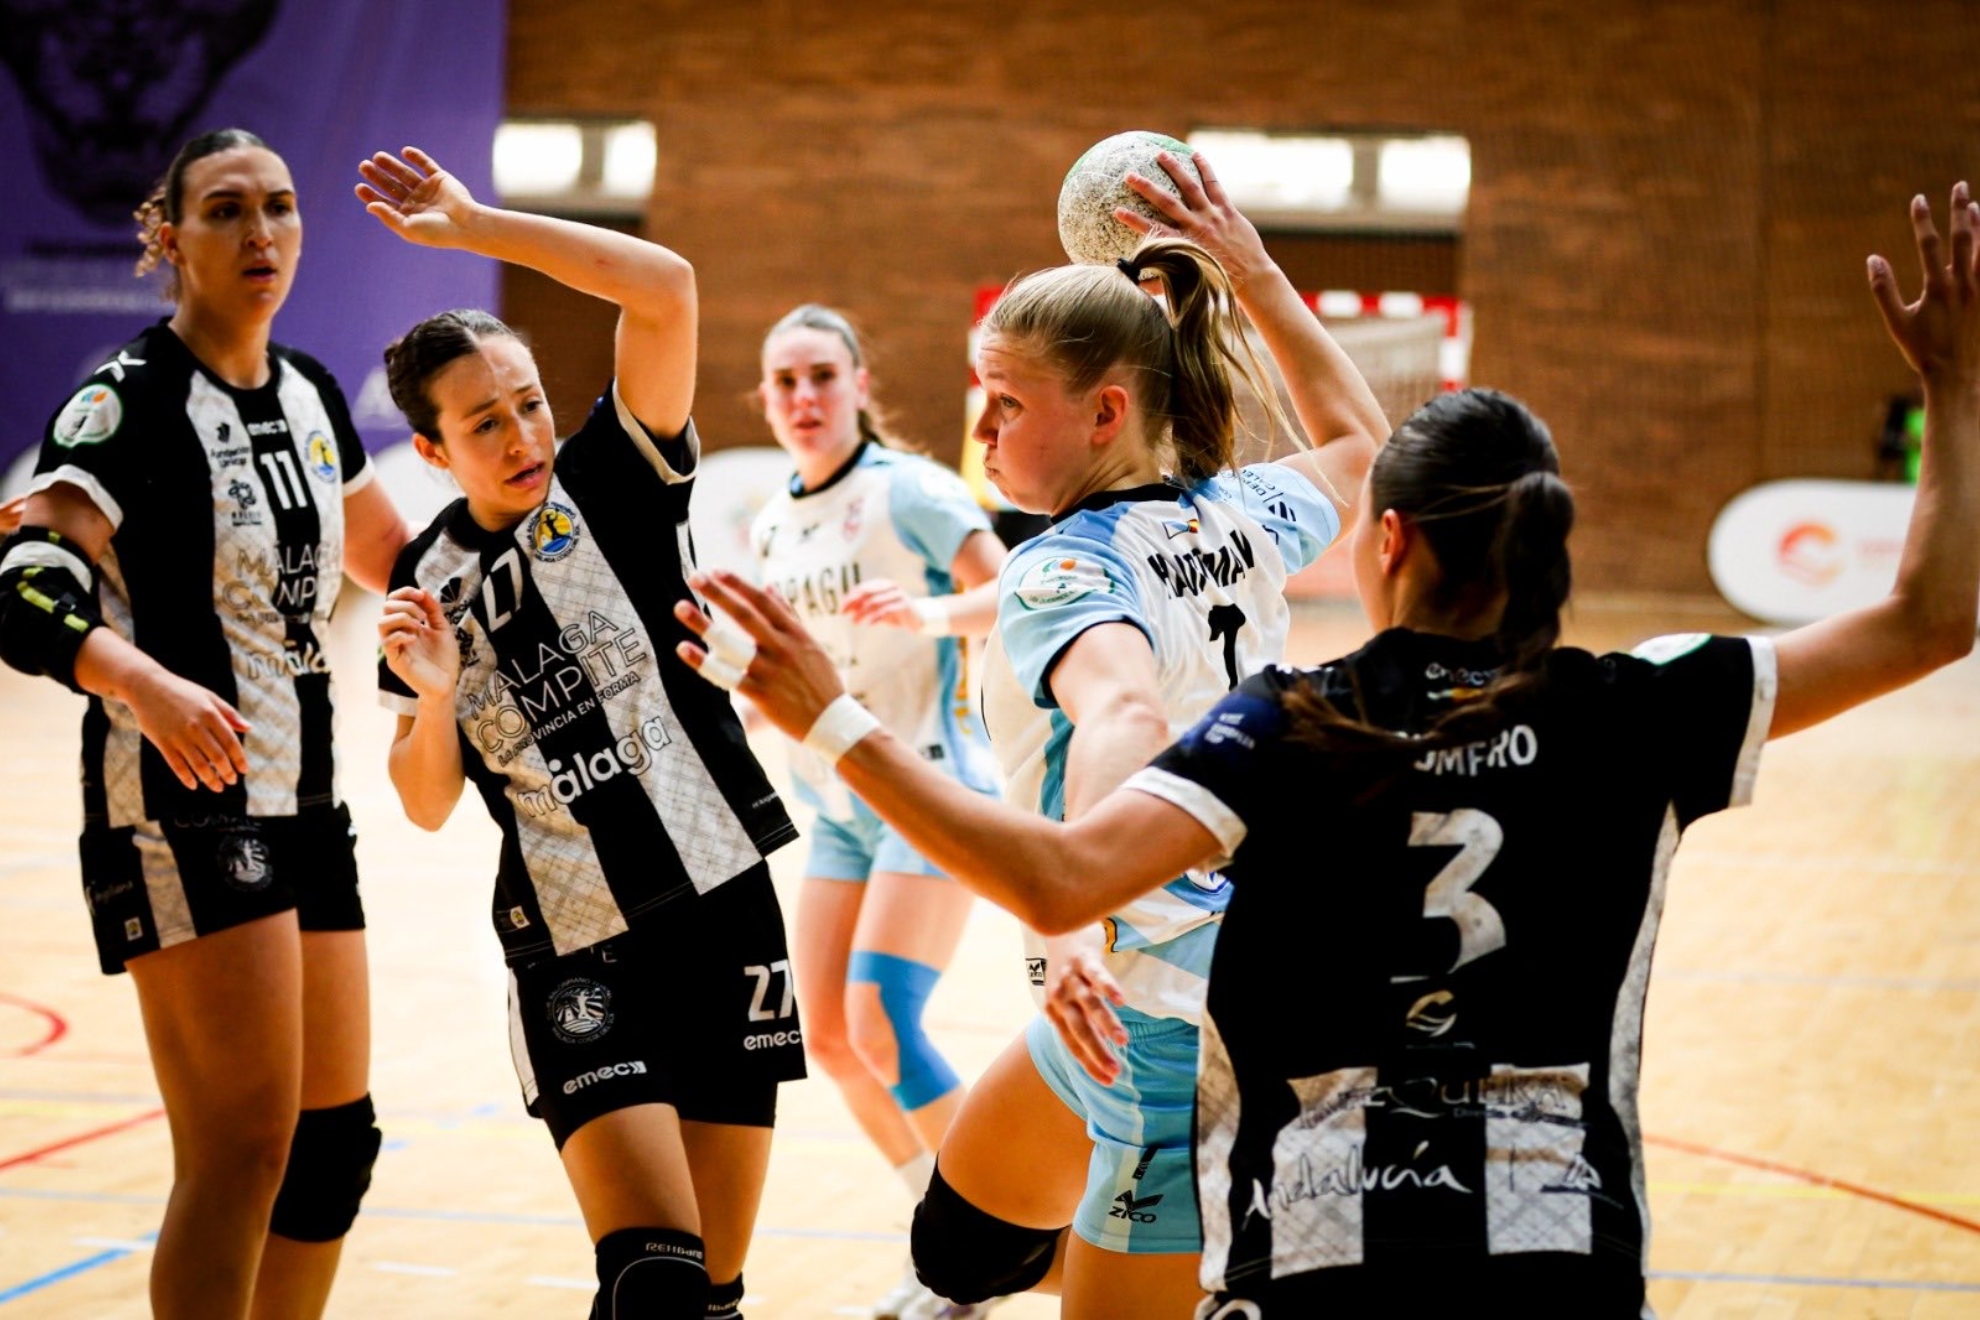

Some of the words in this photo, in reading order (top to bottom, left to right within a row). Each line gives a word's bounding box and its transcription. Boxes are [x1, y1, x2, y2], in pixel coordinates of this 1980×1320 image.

[260, 449, 308, 510] 11
[475, 627, 648, 755] COMPITE
[578, 697, 597, 716] EN
[1406, 808, 1508, 980] 3
[743, 958, 794, 1023] 27
